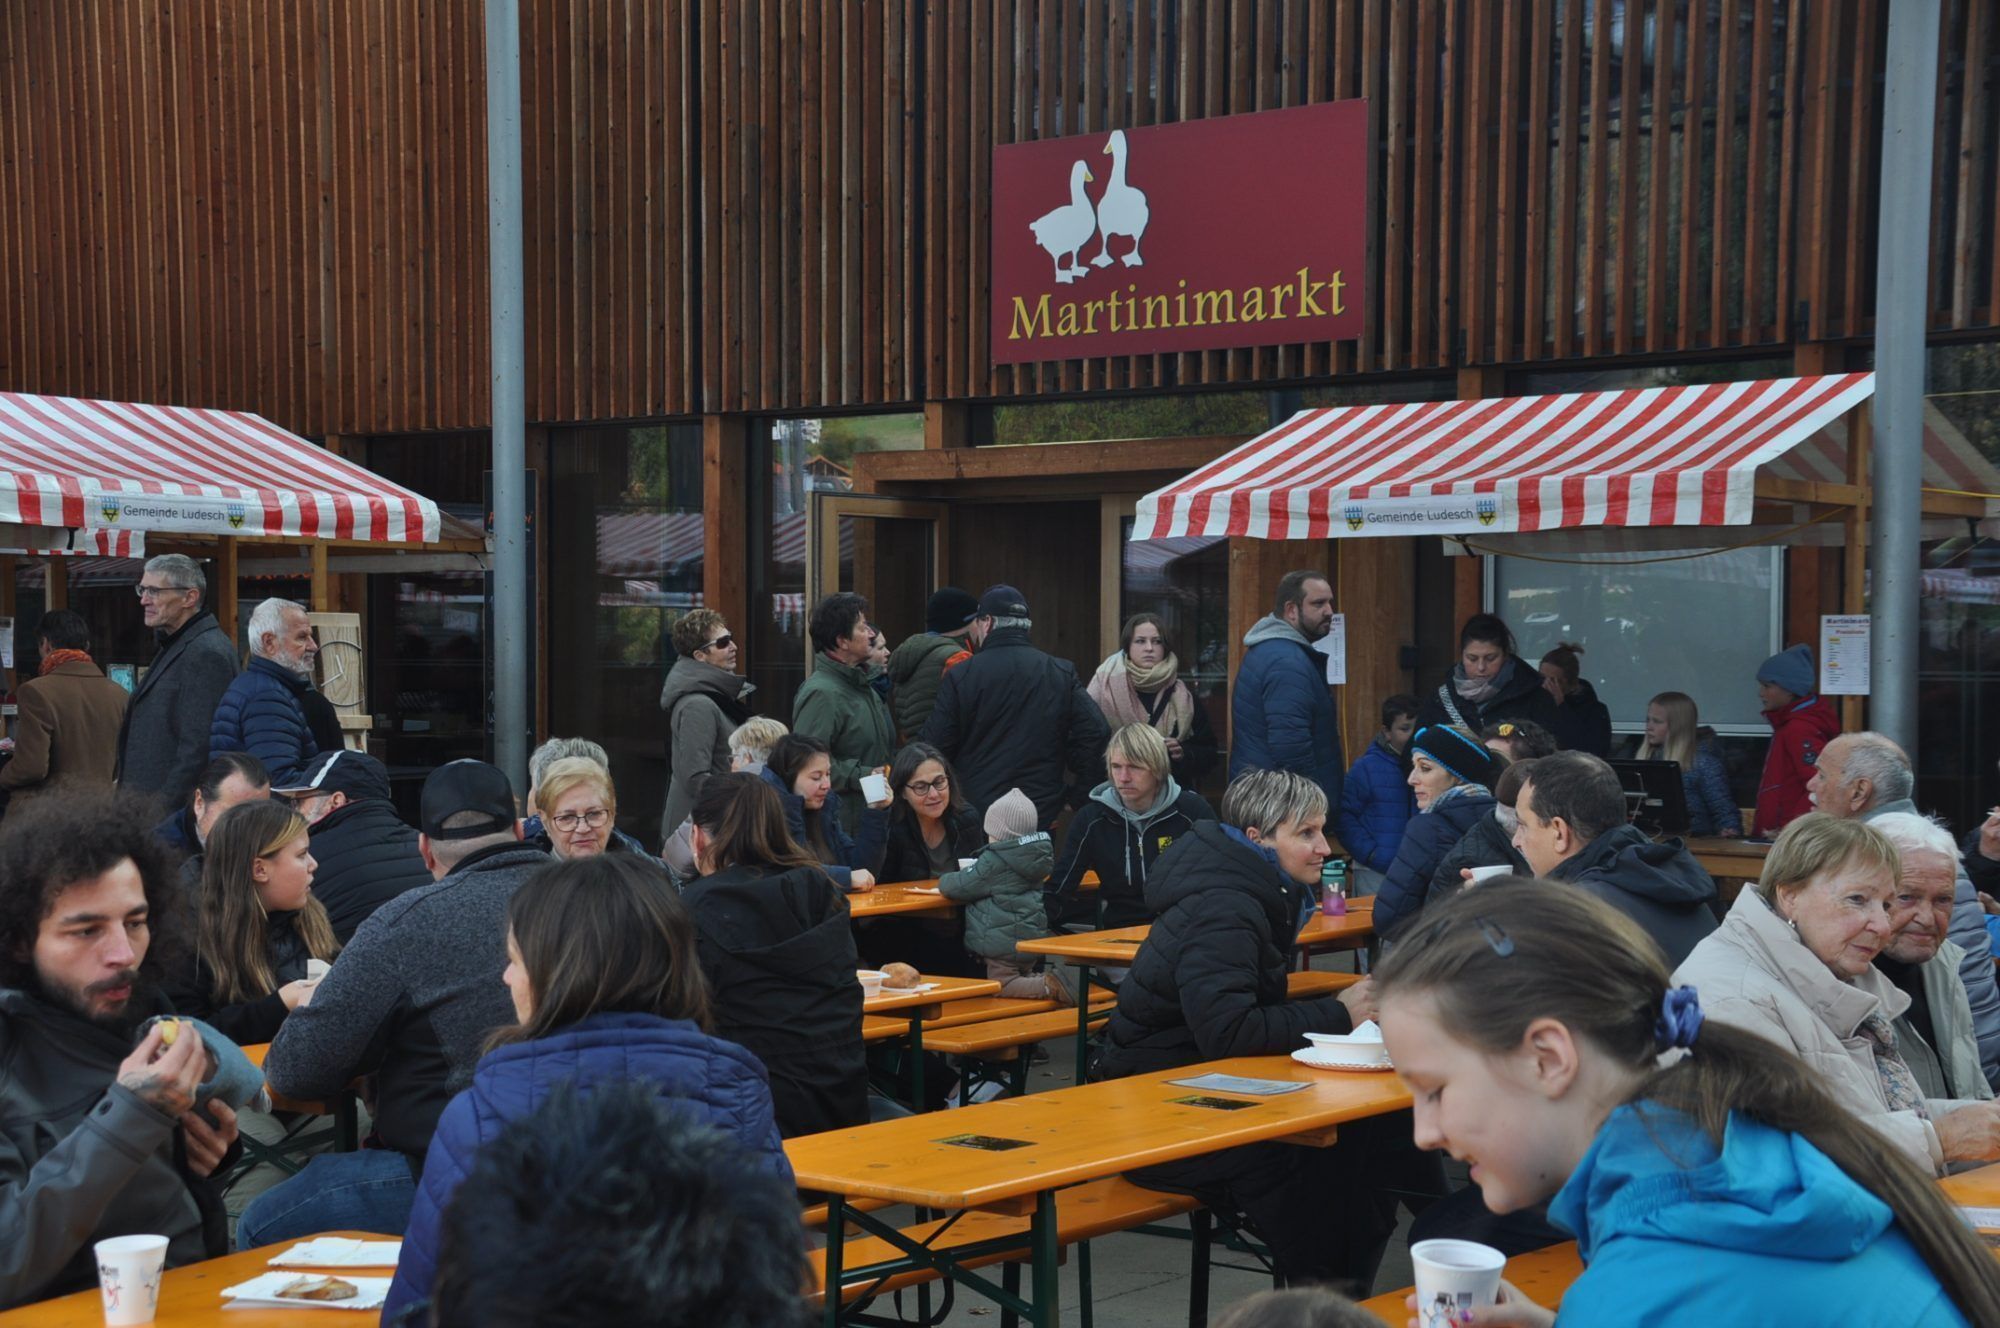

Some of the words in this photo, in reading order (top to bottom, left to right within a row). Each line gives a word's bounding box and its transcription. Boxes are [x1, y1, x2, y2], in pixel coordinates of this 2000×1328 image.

[1008, 266, 1347, 340] Martinimarkt
[123, 504, 179, 519] Gemeinde
[181, 508, 225, 521] Ludesch
[1367, 509, 1424, 524] Gemeinde
[1427, 508, 1474, 521] Ludesch
